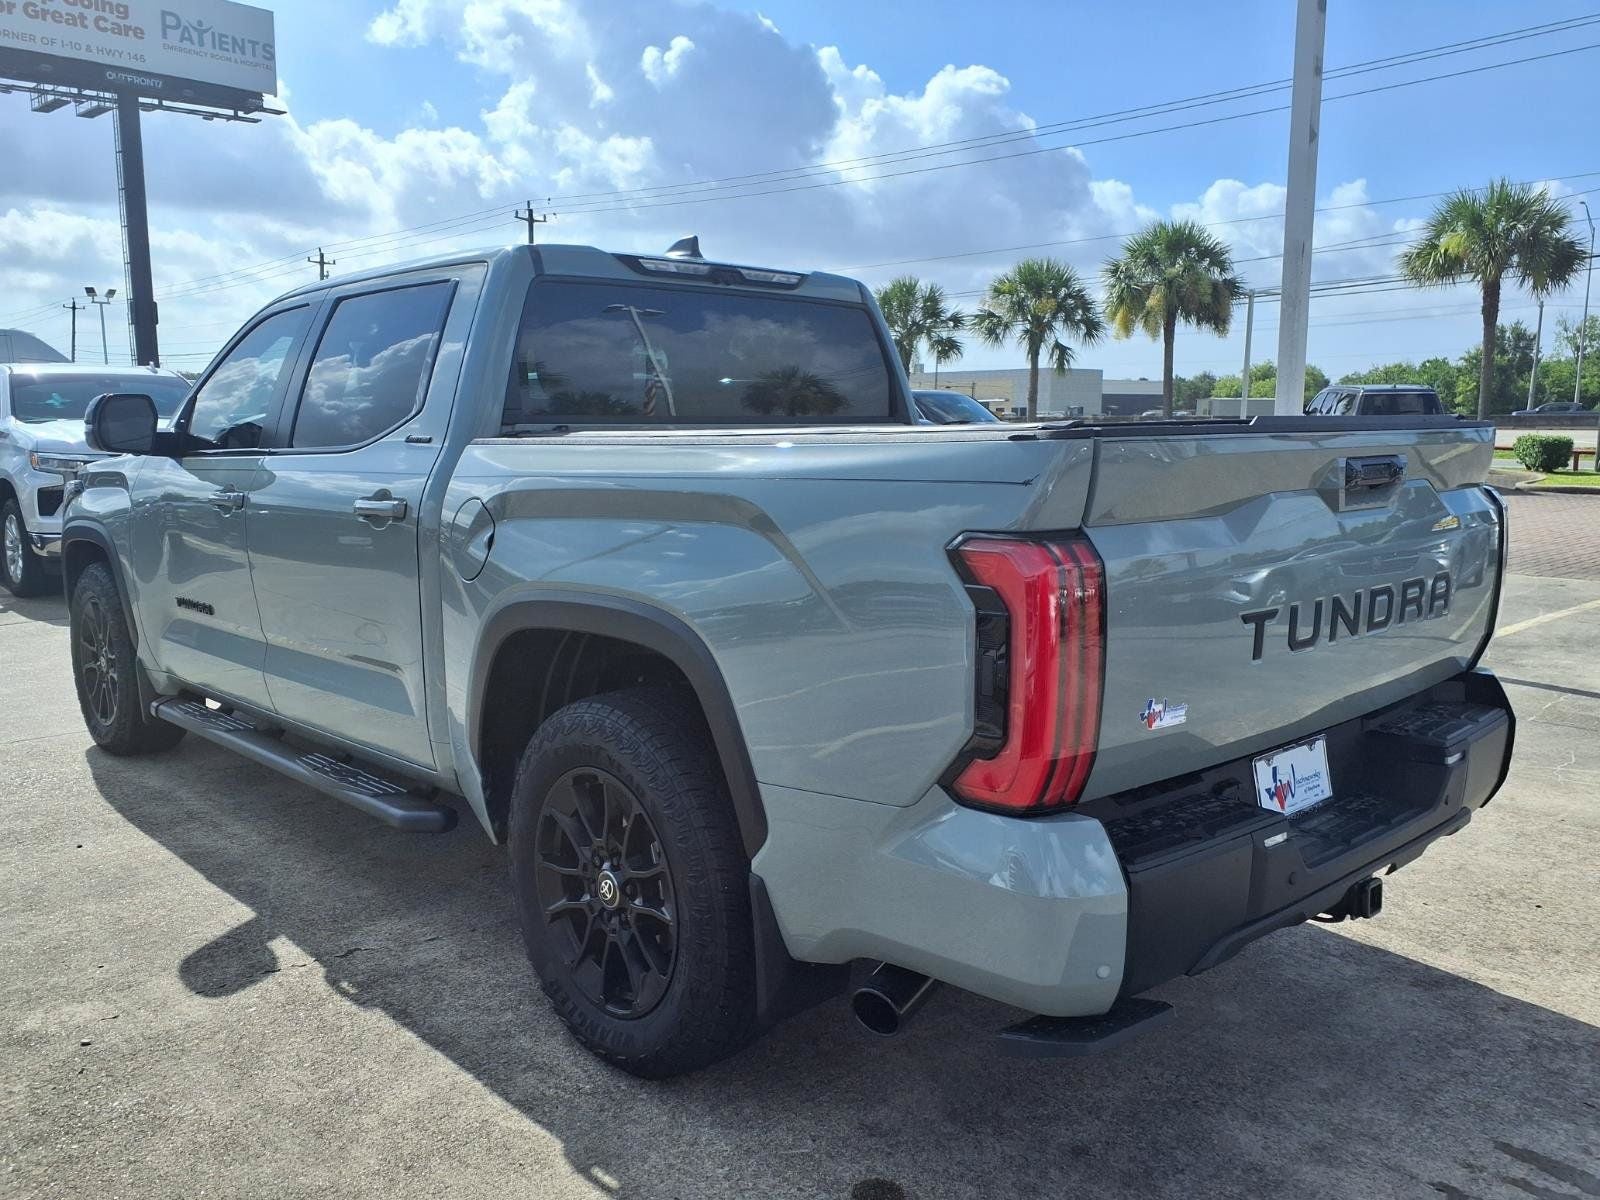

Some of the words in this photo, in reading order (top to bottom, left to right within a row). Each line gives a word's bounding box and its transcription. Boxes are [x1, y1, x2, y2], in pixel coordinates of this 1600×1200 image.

[22, 1, 89, 30] Great
[94, 15, 145, 40] Care
[0, 29, 37, 44] RNER
[40, 36, 57, 47] OF
[61, 39, 82, 51] I-10
[96, 46, 124, 59] HWY
[1238, 569, 1450, 664] TUNDRA
